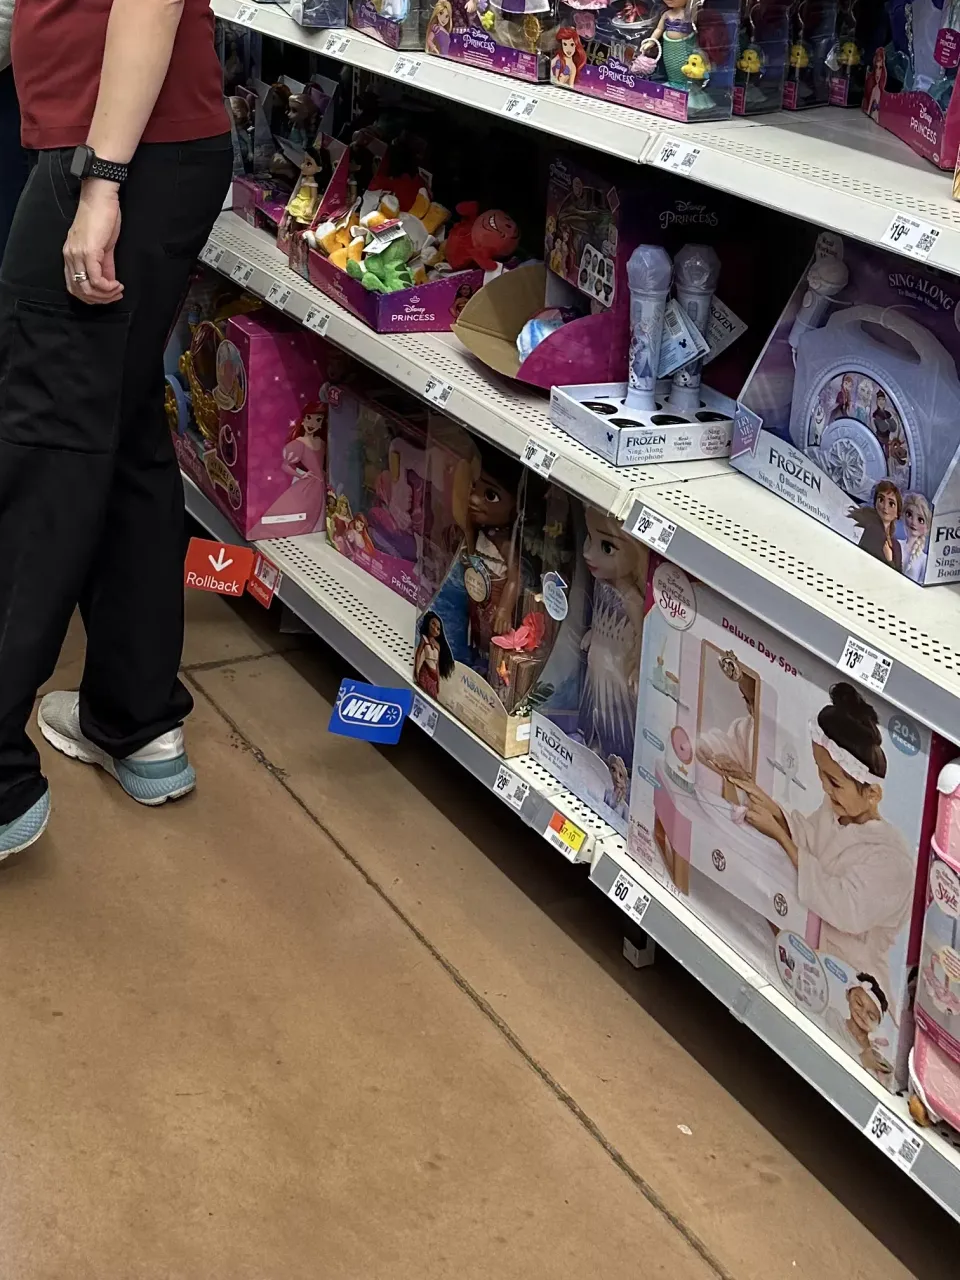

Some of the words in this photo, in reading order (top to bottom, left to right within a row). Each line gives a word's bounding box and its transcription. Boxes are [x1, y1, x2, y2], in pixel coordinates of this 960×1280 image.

[462, 34, 496, 54] PRINCESS
[471, 27, 489, 42] Disney
[598, 65, 635, 88] PRINCESS
[609, 58, 628, 75] Disney
[919, 102, 933, 126] Disney
[909, 116, 937, 145] PRINCESS
[674, 200, 707, 213] Disney
[658, 211, 719, 230] PRINCESS
[888, 273, 915, 288] SING
[915, 279, 955, 311] ALONG
[391, 313, 436, 322] PRINCESS
[403, 304, 426, 314] Disney
[710, 305, 735, 333] ROZEN
[626, 433, 667, 448] FROZEN
[627, 446, 664, 456] Sing-Along
[625, 453, 665, 462] Microphone
[788, 449, 804, 465] Disney
[768, 446, 822, 494] FROZEN
[757, 470, 797, 504] Sing-Along
[796, 493, 831, 523] Boombox
[186, 571, 239, 594] Rollback
[400, 569, 422, 594] Disney
[657, 578, 691, 607] PRINCESS
[666, 572, 684, 594] Disney
[659, 590, 687, 619] Style
[721, 616, 756, 648] Deluxe
[757, 641, 776, 664] Day
[460, 673, 488, 702] MOANA
[341, 698, 389, 723] NEW
[894, 719, 917, 743] 20+
[535, 725, 574, 764] FROZEN
